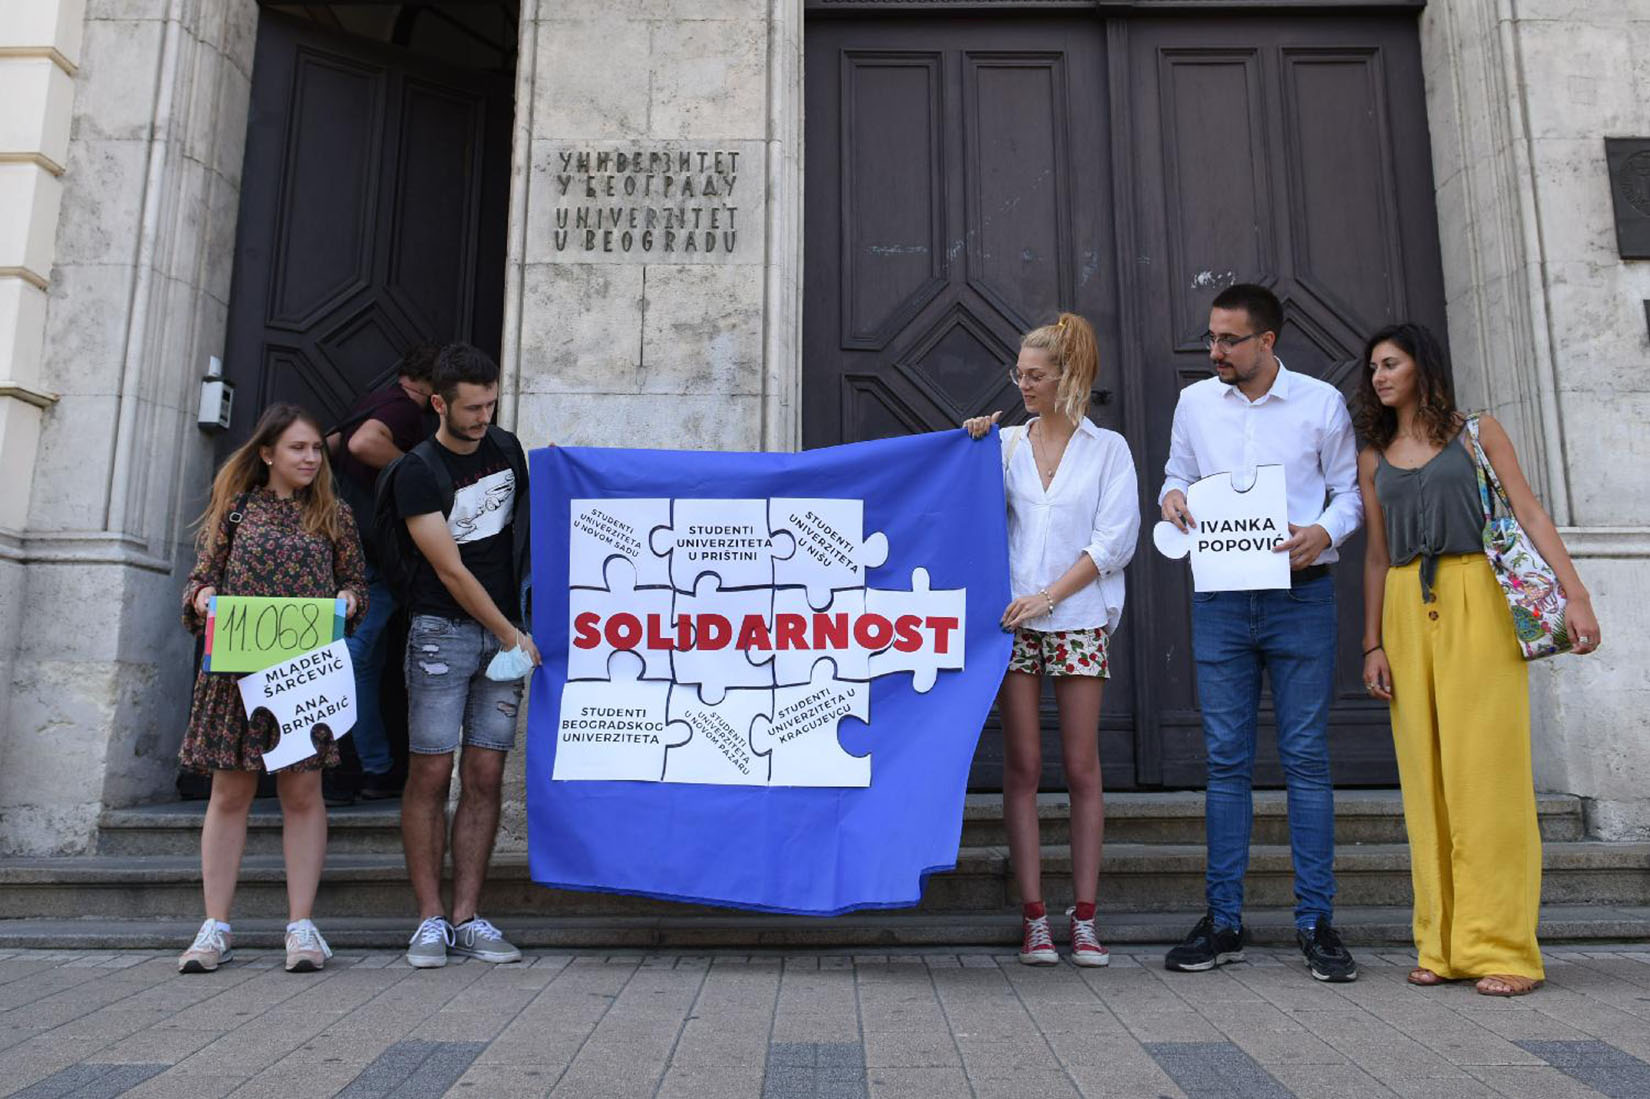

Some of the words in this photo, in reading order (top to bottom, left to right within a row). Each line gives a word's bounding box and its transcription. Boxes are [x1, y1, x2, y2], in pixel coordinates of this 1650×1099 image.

[559, 151, 739, 173] УНИВЕРЗИТЕТ
[557, 174, 571, 196] У
[585, 174, 737, 198] БЕОГРАДУ
[556, 207, 738, 230] UNIVERZITET
[554, 230, 568, 252] U
[585, 230, 737, 252] BEOGRADU
[580, 513, 641, 549] UNIVERZITETA
[591, 508, 634, 534] STUDENTI
[689, 525, 754, 535] STUDENTI
[805, 511, 854, 553] STUDENTI
[1200, 517, 1276, 534] IVANKA
[573, 520, 581, 528] U
[580, 524, 613, 545] NOVOM
[614, 541, 639, 558] SADU
[676, 538, 773, 548] UNIVERZITETA
[789, 513, 859, 574] UNIVERZITETA
[798, 537, 807, 547] U
[807, 544, 832, 567] NIŠU
[1198, 533, 1284, 553] POPOVIĆ
[688, 551, 697, 561] U
[701, 549, 757, 561] PRIŠTINI
[222, 602, 320, 652] 11.068
[573, 612, 959, 654] SOLIDARNOST
[264, 656, 344, 698] ŠARČEVIĆ
[265, 649, 333, 683] MLADEN
[295, 694, 329, 716] ANA
[580, 707, 647, 718] STUDENTI
[767, 694, 846, 736] UNIVERZITETA
[846, 688, 856, 697] U
[778, 687, 831, 718] STUDENTI
[562, 720, 663, 731] BEOGRADSKOG
[562, 733, 660, 744] UNIVERZITETA
[698, 711, 750, 764] UNIVERZITETA
[710, 712, 746, 748] STUDENTI
[779, 703, 851, 744] KRAGUJEVCU
[684, 710, 692, 718] U
[691, 716, 719, 745] NOVOM
[718, 743, 750, 775] PAZARU
